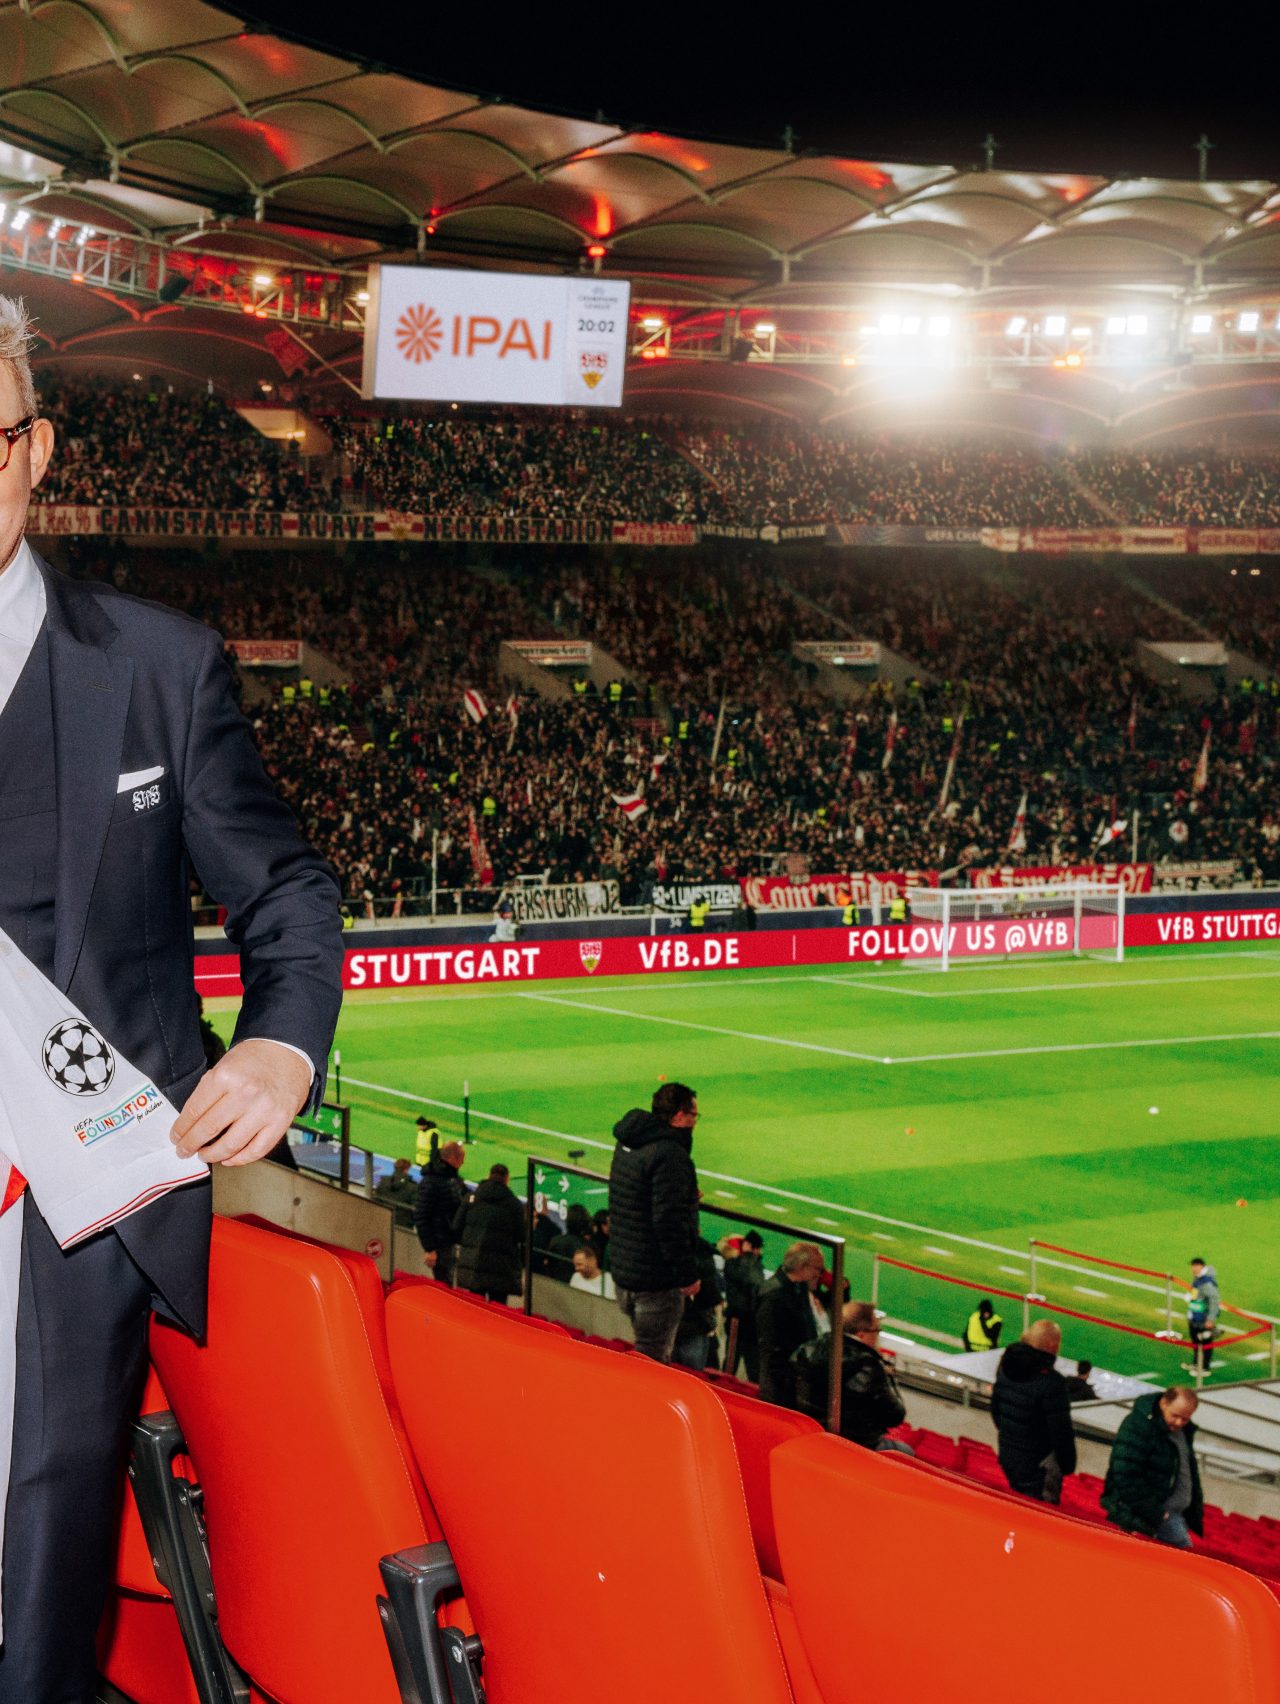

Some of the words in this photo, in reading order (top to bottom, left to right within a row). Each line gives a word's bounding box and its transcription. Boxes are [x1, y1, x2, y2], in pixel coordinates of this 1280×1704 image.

[452, 314, 552, 360] IPAI
[578, 319, 615, 333] 20:02
[100, 509, 283, 537] CANNSTATTER
[297, 513, 375, 539] KURVE
[423, 516, 614, 542] NECKARSTADION
[848, 927, 957, 956] FOLLOW
[966, 924, 995, 950] US
[1005, 920, 1068, 952] @VfB
[1157, 916, 1194, 941] VfB
[1202, 913, 1280, 939] STUTTG
[350, 947, 540, 985] STUTTGART
[638, 939, 739, 969] VfB.DE
[74, 1118, 93, 1132] UEFA
